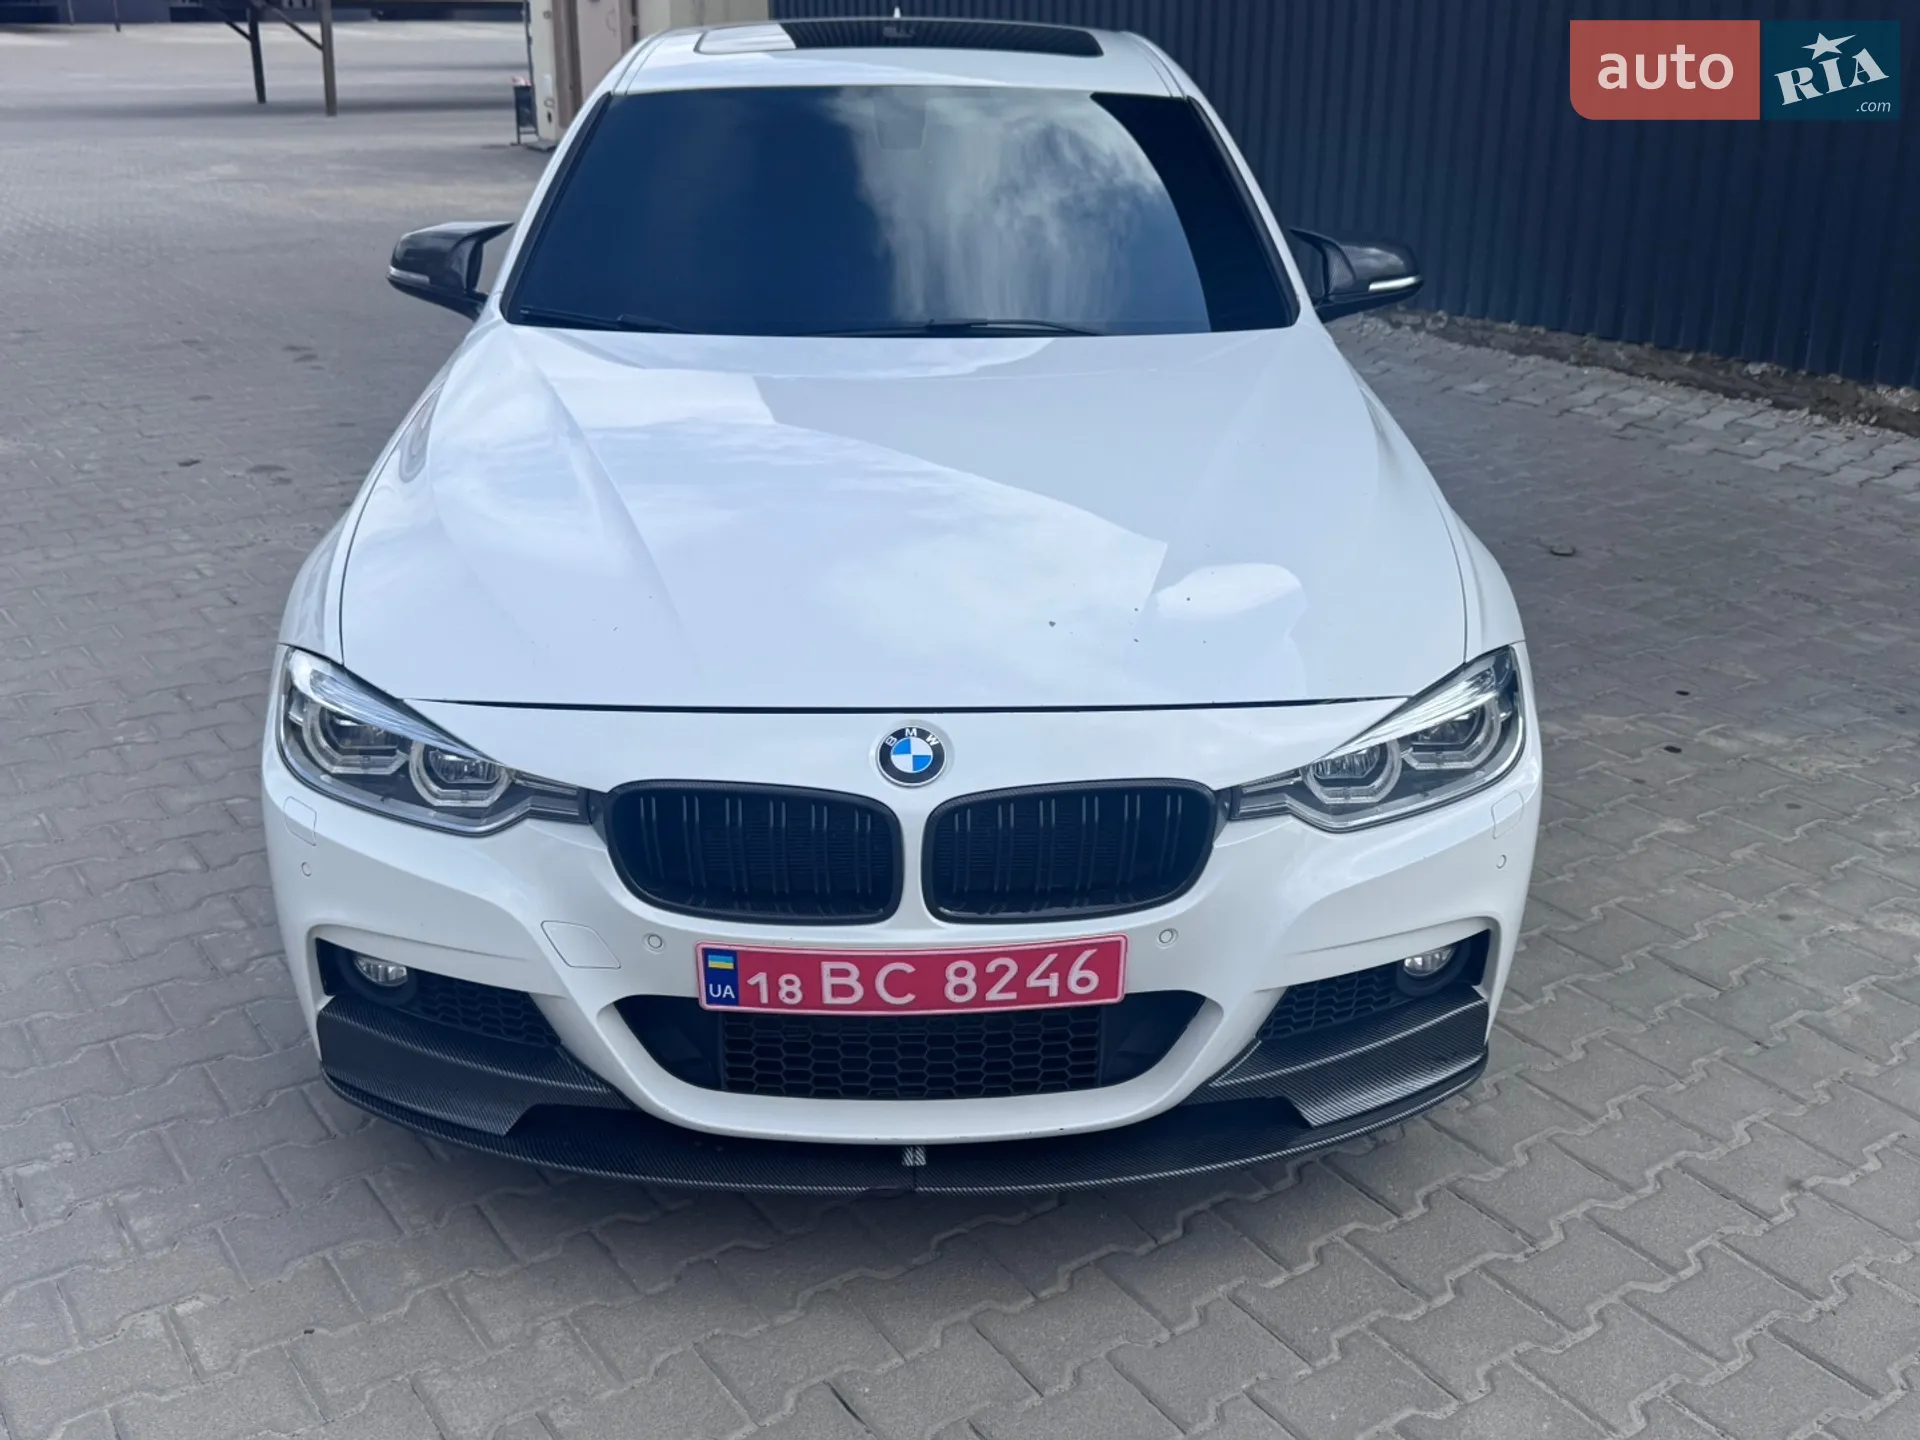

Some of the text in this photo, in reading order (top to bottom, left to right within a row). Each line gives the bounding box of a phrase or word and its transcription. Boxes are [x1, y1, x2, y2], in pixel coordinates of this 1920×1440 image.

[885, 728, 940, 746] BMW
[747, 949, 1100, 1005] 18 BC 8246
[709, 983, 736, 999] UA
